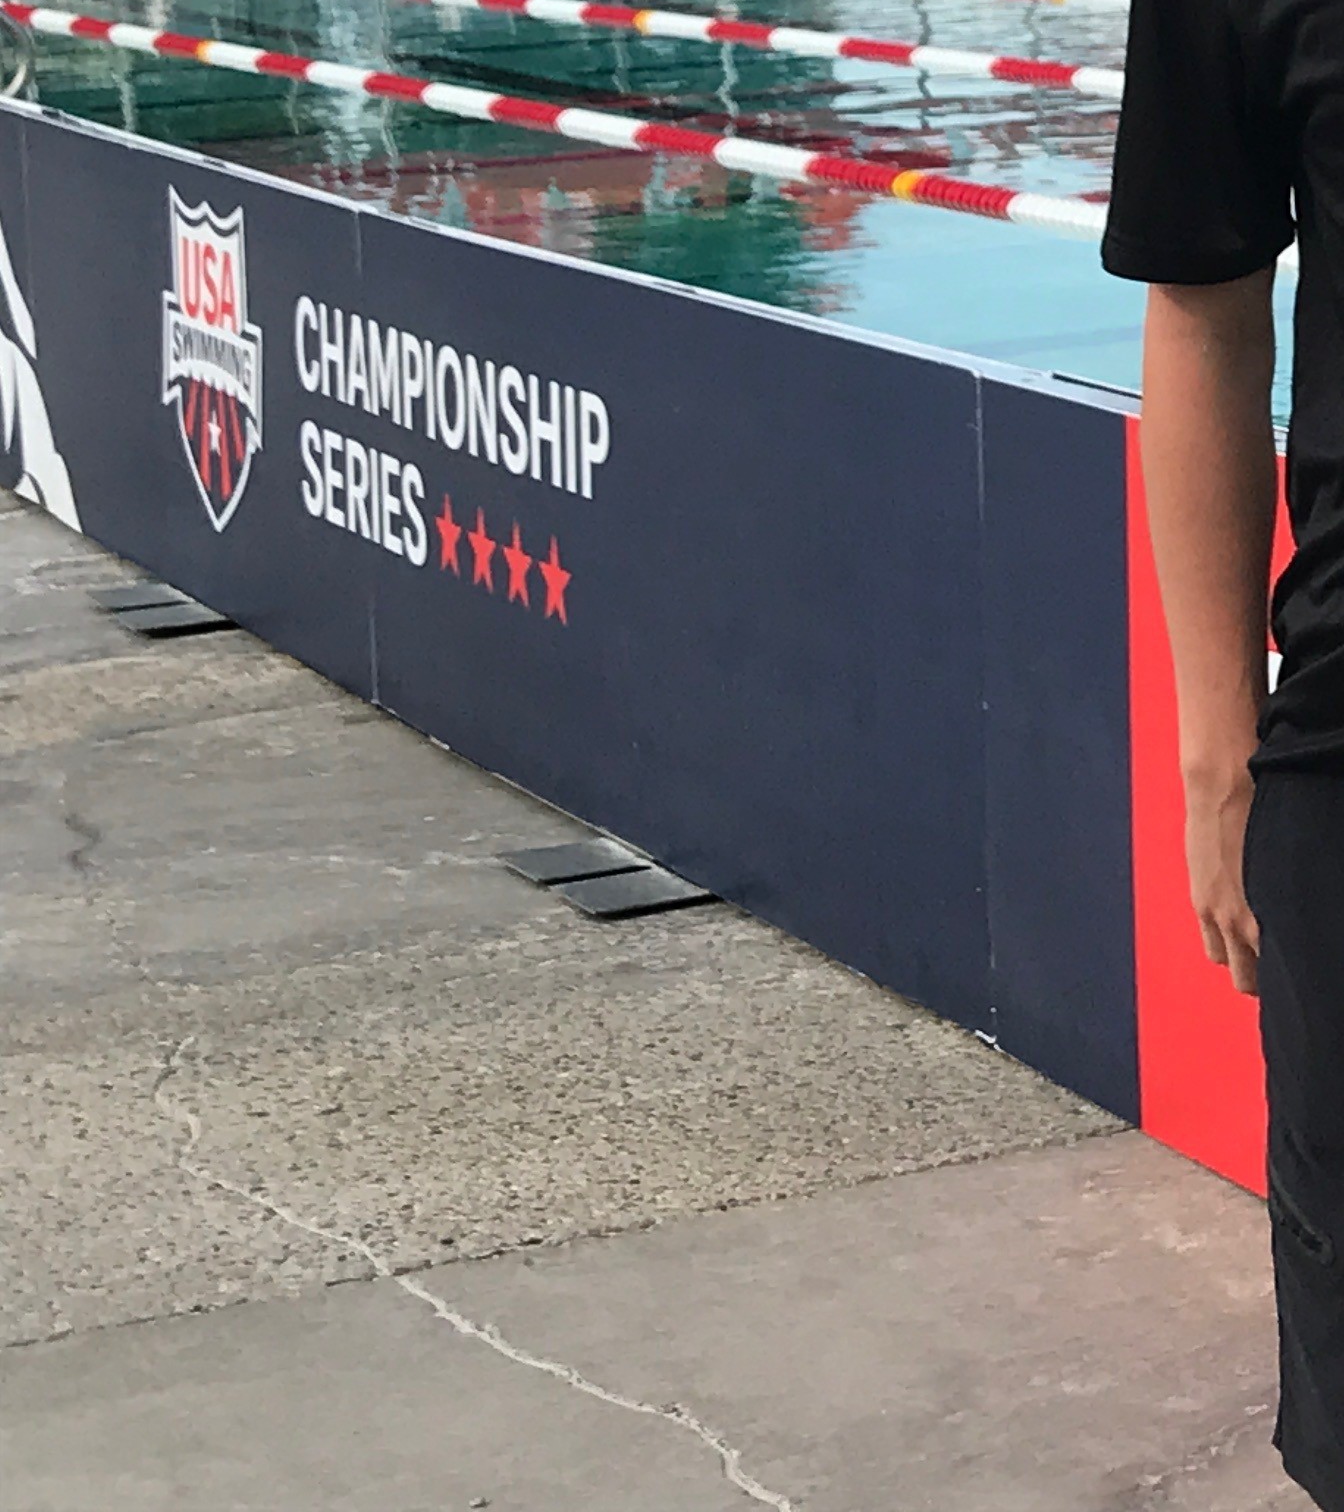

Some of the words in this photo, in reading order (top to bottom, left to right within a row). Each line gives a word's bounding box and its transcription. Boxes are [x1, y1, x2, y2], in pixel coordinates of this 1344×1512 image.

[180, 236, 239, 337] USA
[172, 320, 253, 391] SWIMMING
[294, 294, 611, 500] CHAMPIONSHIP
[300, 418, 429, 567] SERIES
